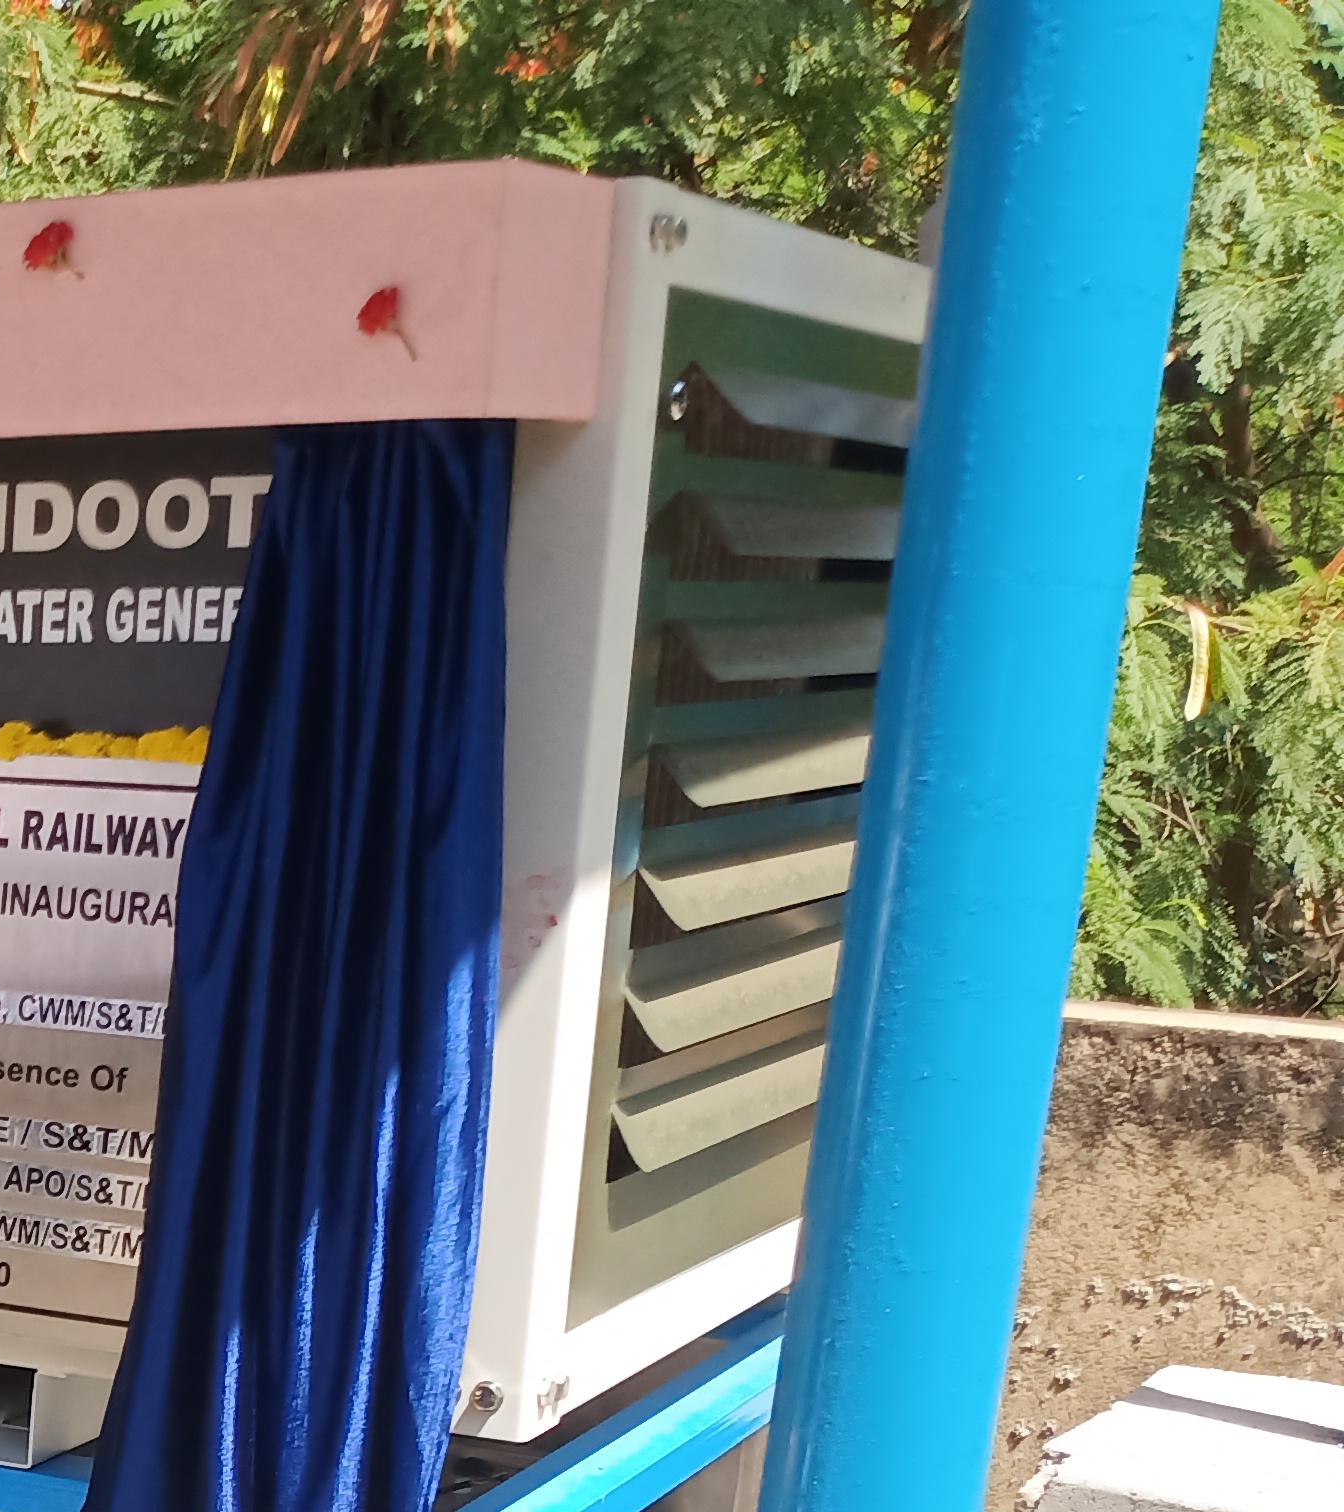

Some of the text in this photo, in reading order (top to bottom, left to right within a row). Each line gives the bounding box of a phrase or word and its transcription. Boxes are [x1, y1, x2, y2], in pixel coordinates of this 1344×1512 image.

[20, 809, 186, 859] RAILWAY
[0, 882, 177, 928] INAUGURA
[18, 994, 167, 1036] CWM/S&T/
[90, 1064, 129, 1093] Of
[3, 1165, 148, 1210] APO/S&T/
